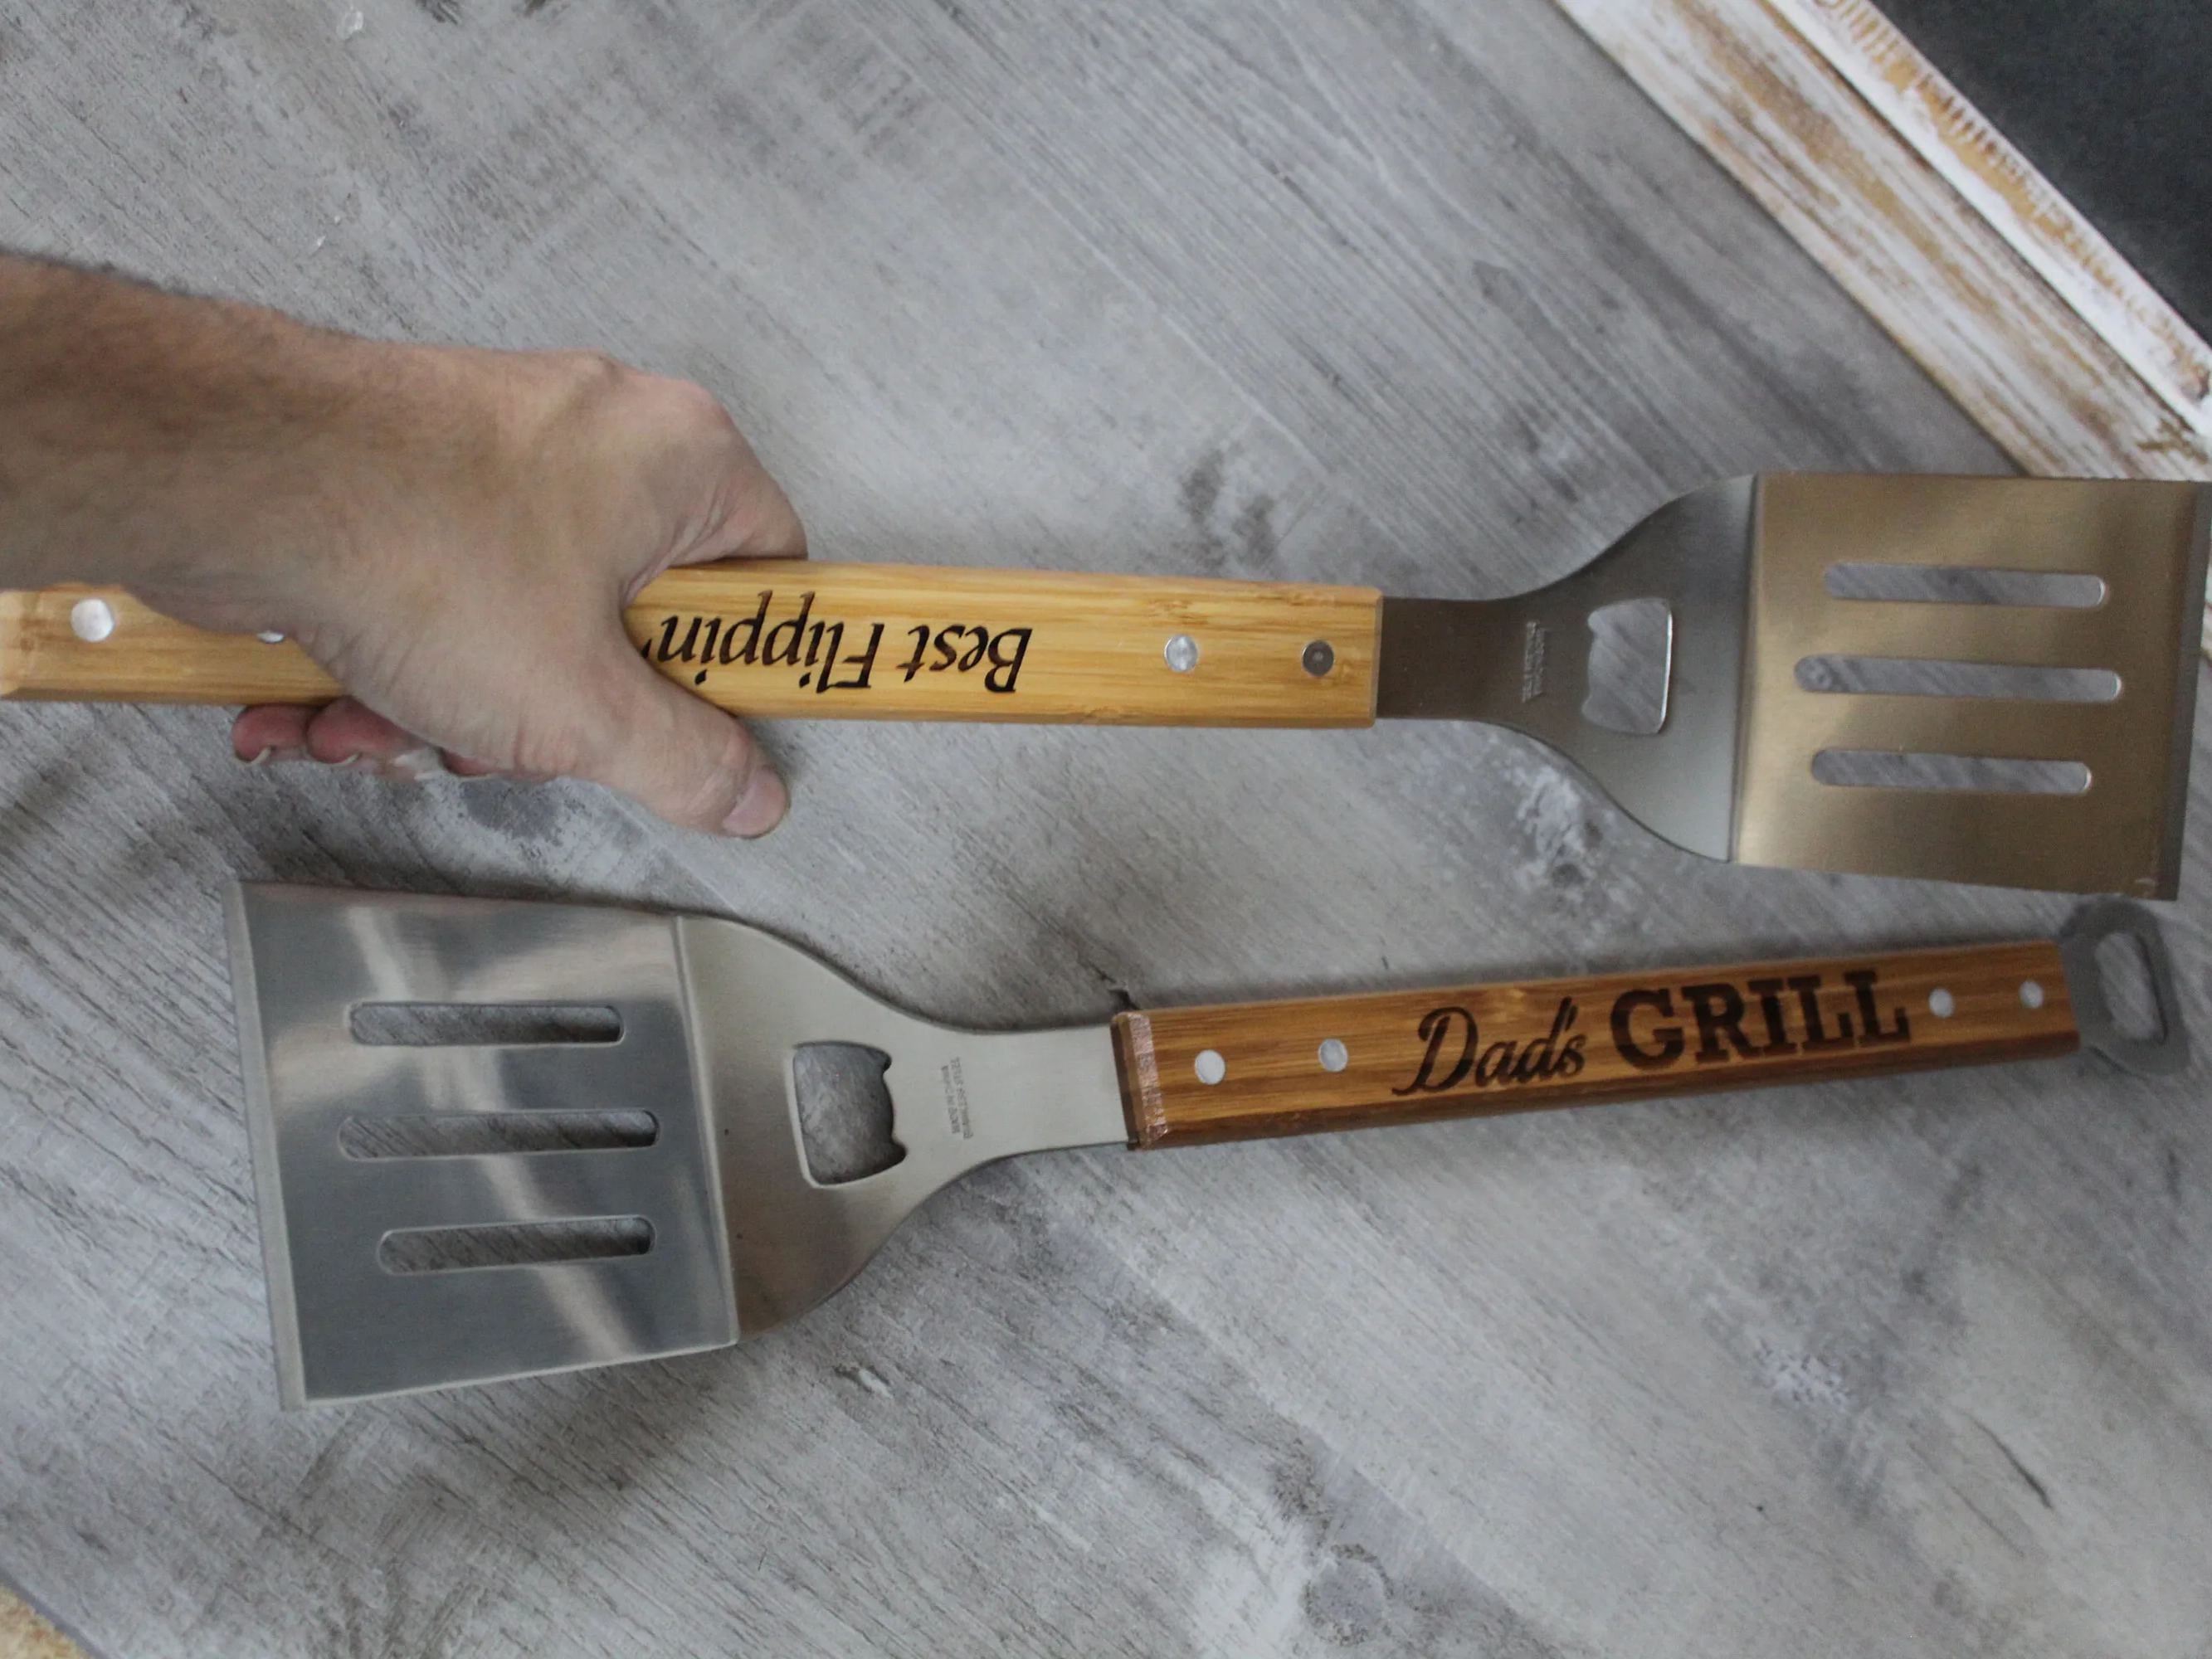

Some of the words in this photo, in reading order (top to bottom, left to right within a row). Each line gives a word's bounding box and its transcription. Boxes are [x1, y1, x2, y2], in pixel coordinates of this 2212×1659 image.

[895, 623, 1033, 693] Best
[1391, 996, 1587, 1097] Dad's
[1610, 970, 1909, 1071] GRILL
